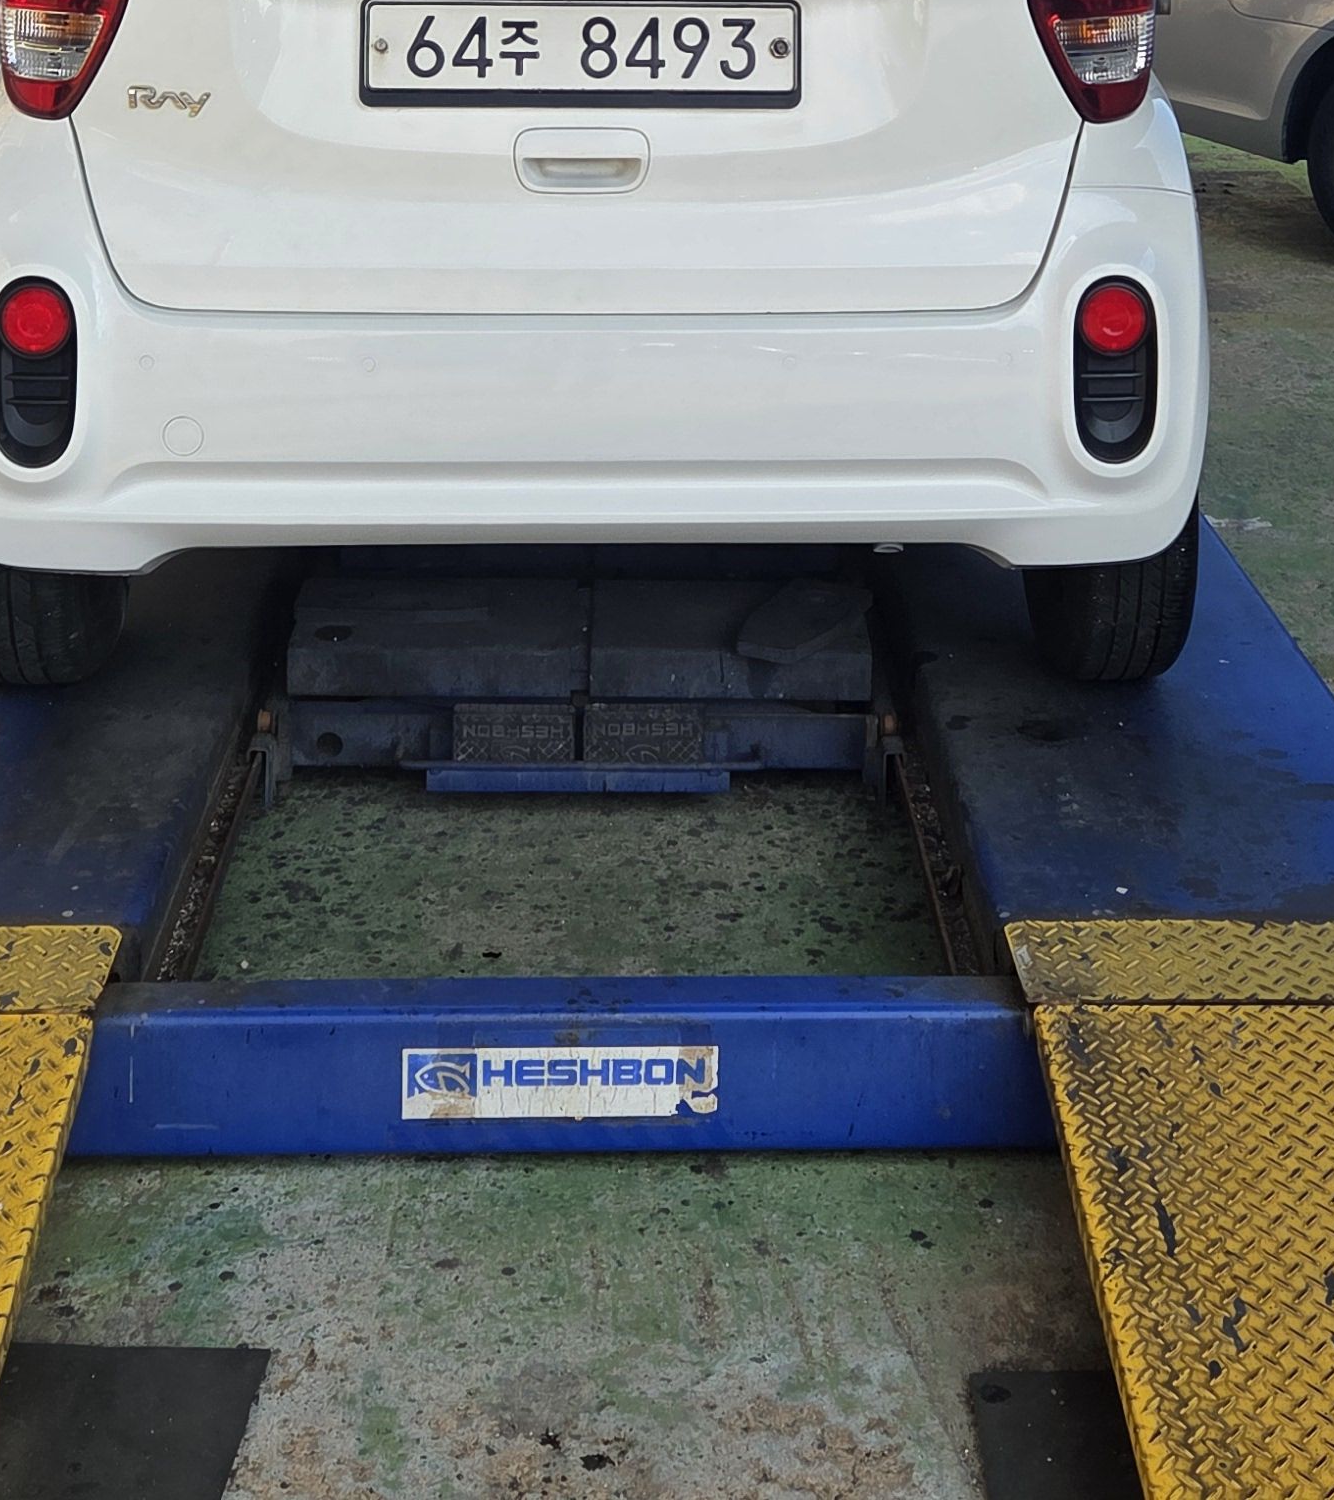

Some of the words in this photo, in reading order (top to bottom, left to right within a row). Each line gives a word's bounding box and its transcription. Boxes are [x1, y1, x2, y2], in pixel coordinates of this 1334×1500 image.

[406, 15, 541, 79] 64주
[581, 16, 757, 80] 8493
[482, 1057, 706, 1087] HESHBON
